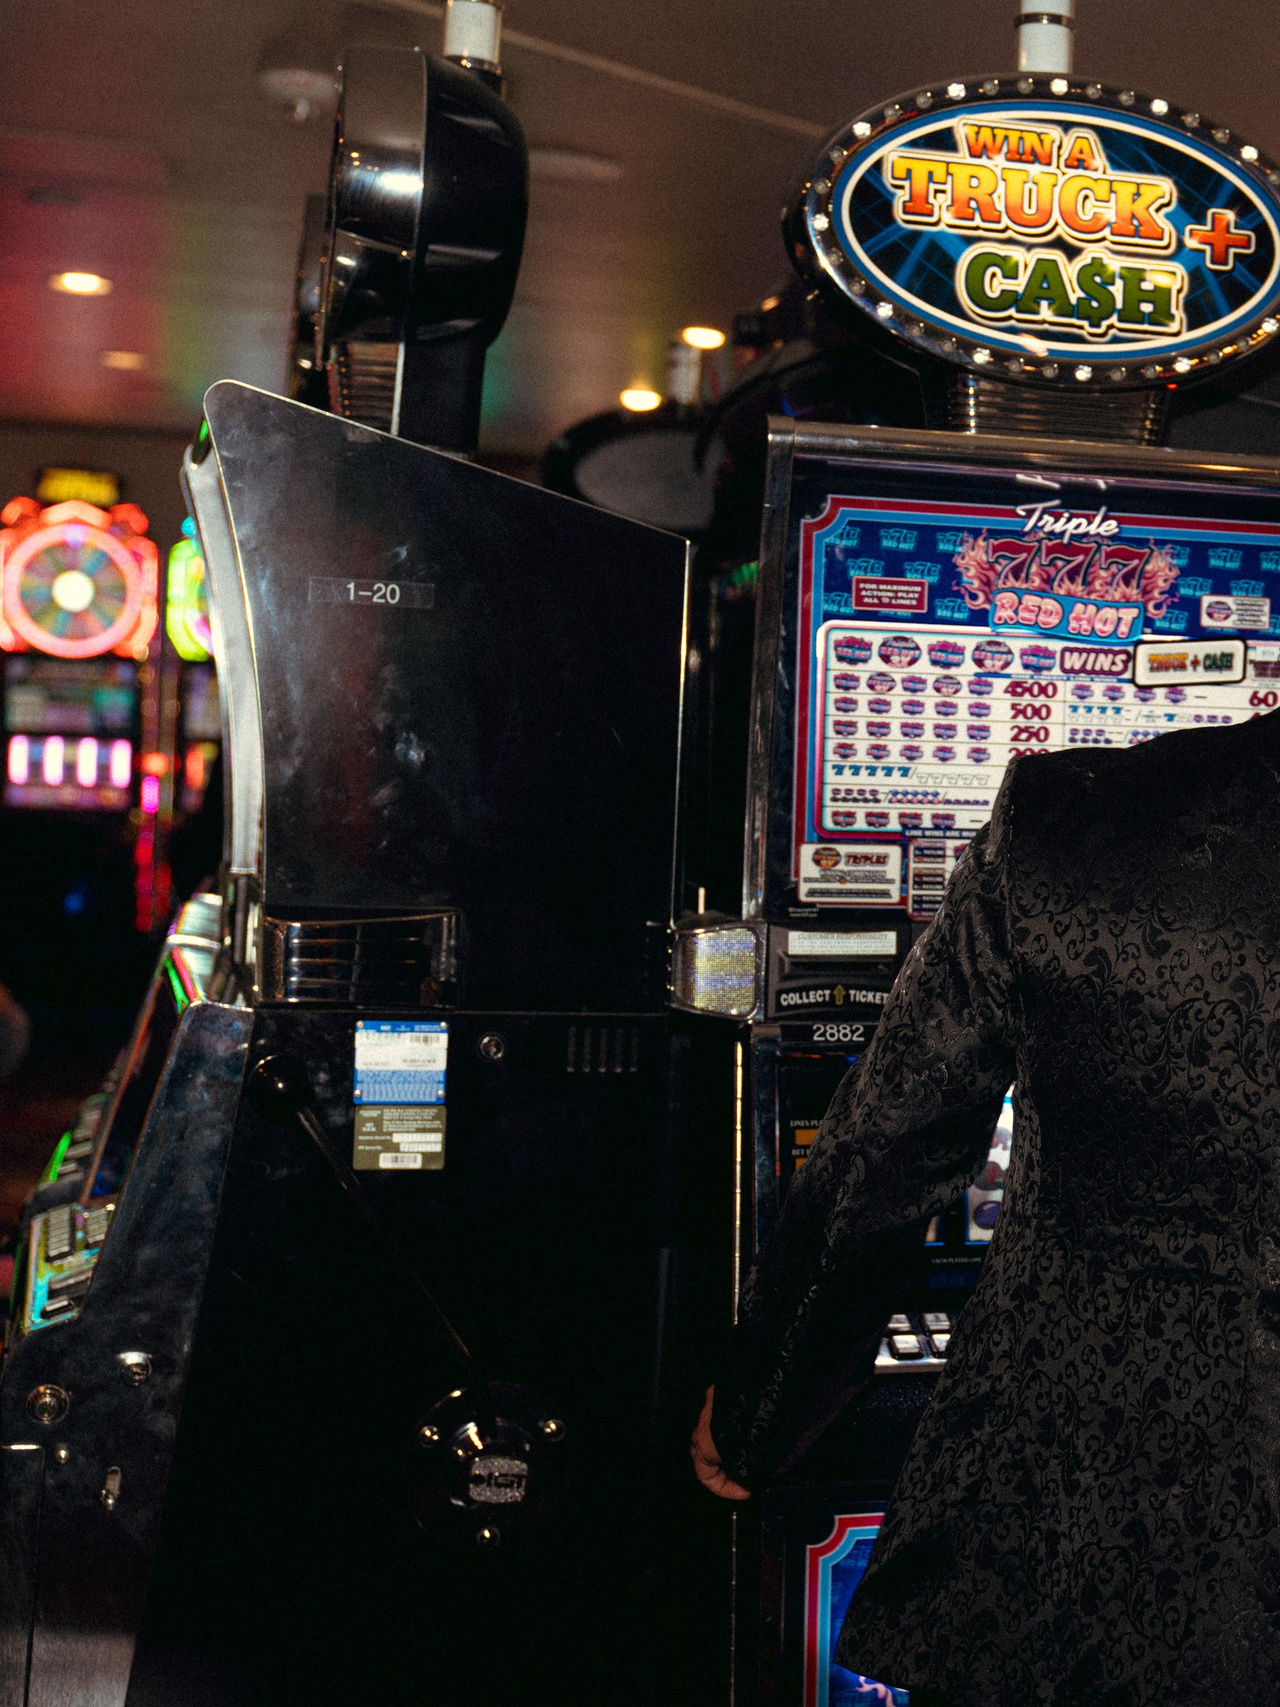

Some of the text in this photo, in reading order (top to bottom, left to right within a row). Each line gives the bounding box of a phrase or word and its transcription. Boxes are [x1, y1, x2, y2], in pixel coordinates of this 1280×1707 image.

[964, 124, 1099, 170] WIN A
[892, 156, 1171, 246] TRUCK
[964, 251, 1180, 330] CA$H
[1015, 499, 1120, 545] Triple
[346, 581, 401, 605] 1-20
[879, 583, 922, 592] MAXIMUM
[897, 591, 920, 599] PLAY
[993, 591, 1140, 639] RED HOT
[1062, 650, 1128, 673] WINS
[1148, 652, 1189, 673] TRUCK
[1003, 680, 1058, 699] 4500
[1248, 690, 1279, 708] 60
[1009, 702, 1052, 721] 500
[1009, 725, 1051, 744] 250
[780, 989, 891, 1006] COLLECT TICKET
[812, 1024, 865, 1042] 2882
